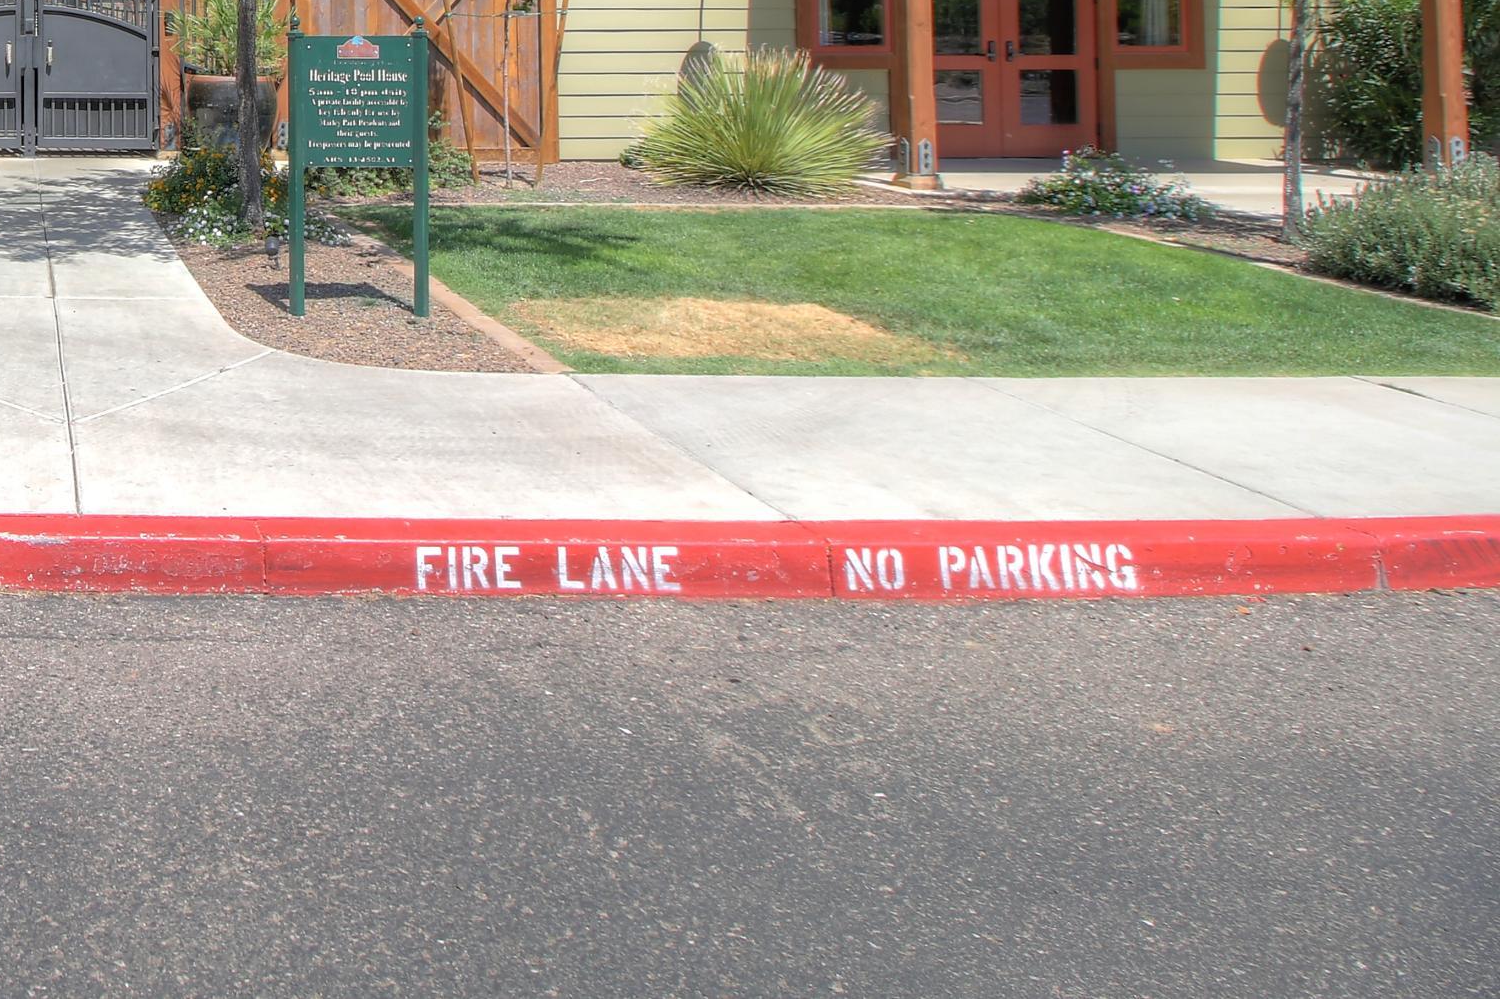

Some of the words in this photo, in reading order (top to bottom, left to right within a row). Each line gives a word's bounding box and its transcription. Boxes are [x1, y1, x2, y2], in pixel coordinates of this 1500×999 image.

[309, 69, 351, 84] Heritage
[353, 69, 375, 82] Pool
[377, 69, 408, 82] House
[345, 88, 358, 96] 10
[360, 89, 378, 97] pm
[381, 88, 407, 97] daily
[317, 99, 341, 107] private
[342, 99, 365, 107] facility
[400, 99, 408, 107] by
[318, 109, 331, 117] key
[391, 109, 400, 117] by
[336, 129, 353, 137] their
[308, 140, 347, 149] Trespassers
[347, 141, 363, 150] may
[364, 140, 373, 148] be
[415, 546, 523, 591] FIRE
[557, 546, 682, 592] LANE
[843, 546, 904, 591] NO
[938, 544, 1139, 592] PARKING
